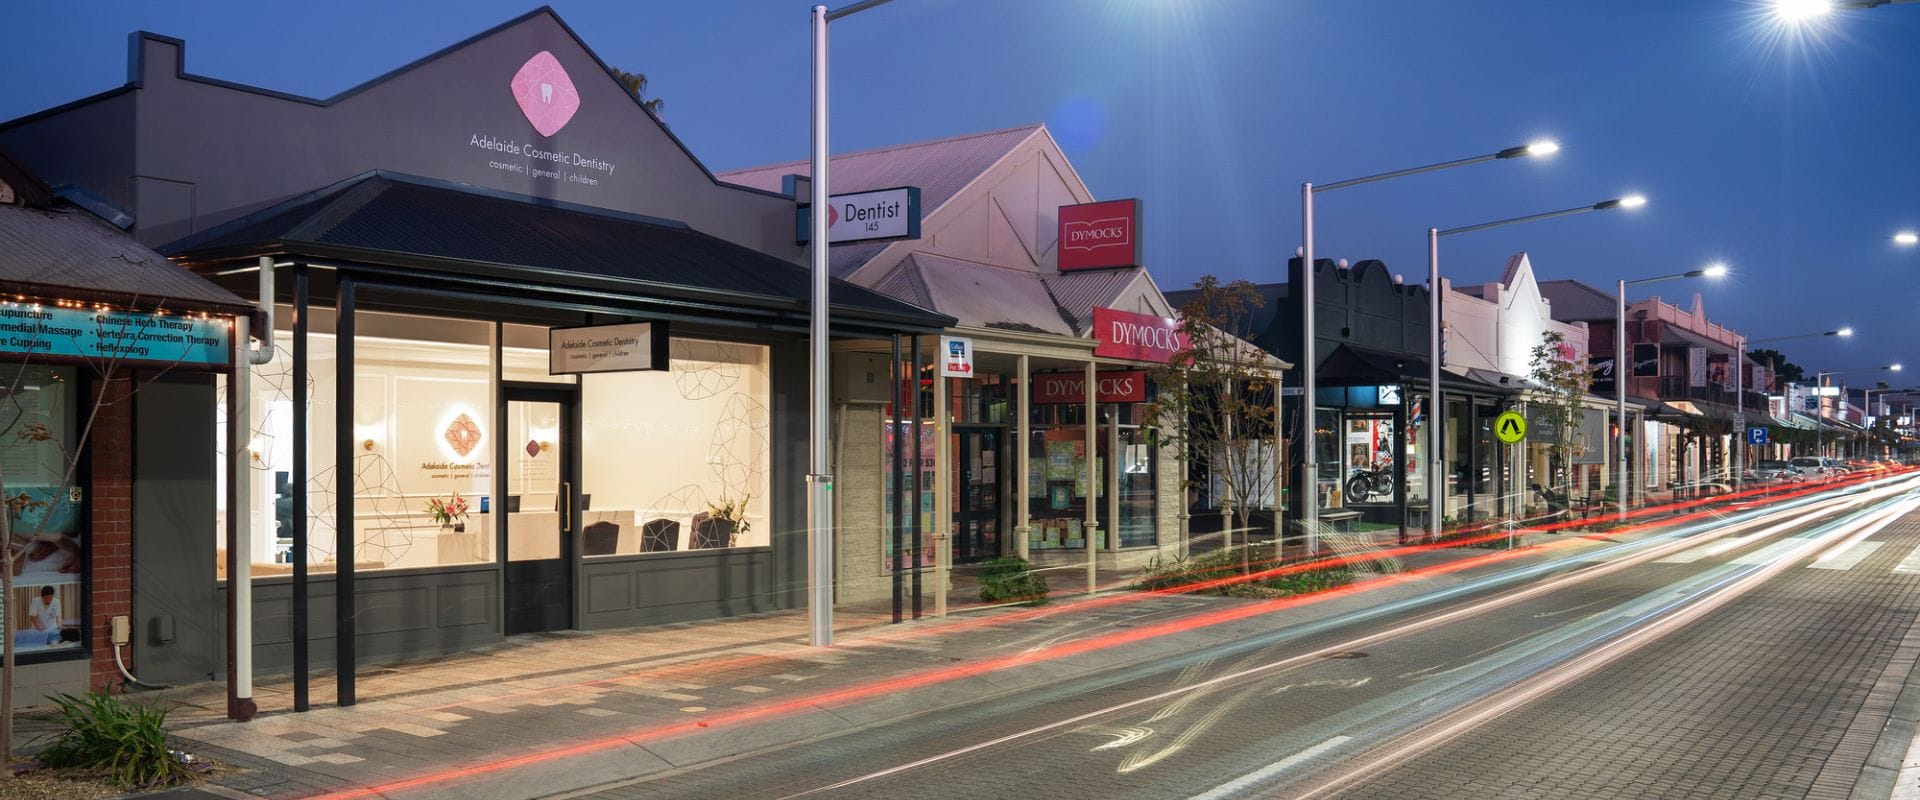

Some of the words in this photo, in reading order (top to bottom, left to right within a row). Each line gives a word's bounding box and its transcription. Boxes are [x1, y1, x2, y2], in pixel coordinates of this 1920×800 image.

[470, 134, 520, 155] Adelaide
[523, 144, 570, 164] Cosmetic
[573, 153, 615, 175] Dentistry
[489, 161, 522, 173] cosmetic
[532, 168, 561, 179] general
[569, 174, 598, 186] children
[845, 201, 900, 222] Dentist
[865, 222, 879, 232] 145
[1071, 226, 1123, 241] DYMOCKS
[0, 323, 36, 333] medial
[39, 324, 83, 338] Massage
[96, 314, 133, 326] Chinese
[135, 317, 157, 328] Herb
[160, 319, 193, 332] Therapy
[10, 336, 52, 350] Cupping
[96, 328, 135, 340] Vertebra
[137, 331, 184, 343] Correction
[186, 334, 220, 347] Therapy
[561, 340, 587, 349] Adelaide
[588, 338, 613, 348] Cosmetic
[614, 337, 639, 347] Dentistry
[1112, 321, 1180, 352] DYMOCKS
[96, 342, 149, 356] Reflexology
[1753, 429, 1763, 440] P
[421, 461, 448, 470] Adelaide
[449, 462, 475, 470] Cosmetic
